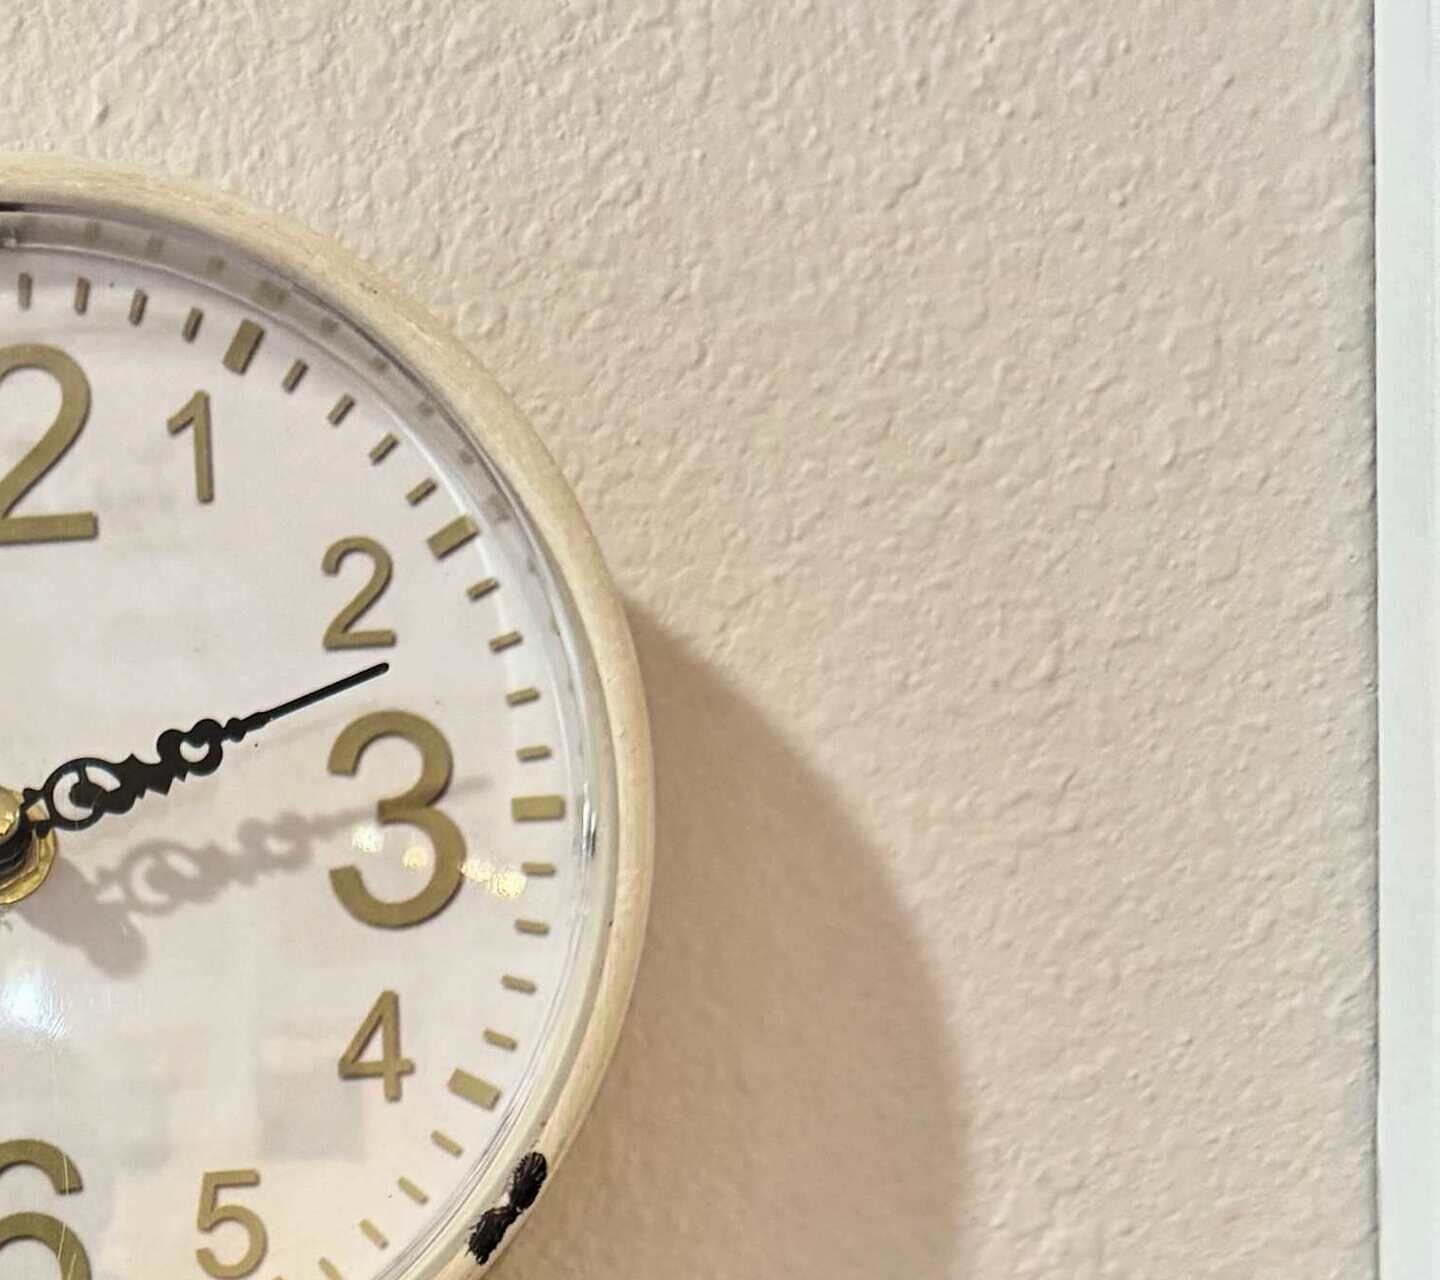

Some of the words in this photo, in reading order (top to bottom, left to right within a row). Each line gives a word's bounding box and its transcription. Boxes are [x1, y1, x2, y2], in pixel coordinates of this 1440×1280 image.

[167, 391, 214, 503] 1
[320, 537, 395, 650] 2
[326, 709, 466, 929] 3
[339, 990, 413, 1102] 4
[194, 1168, 268, 1280] 5
